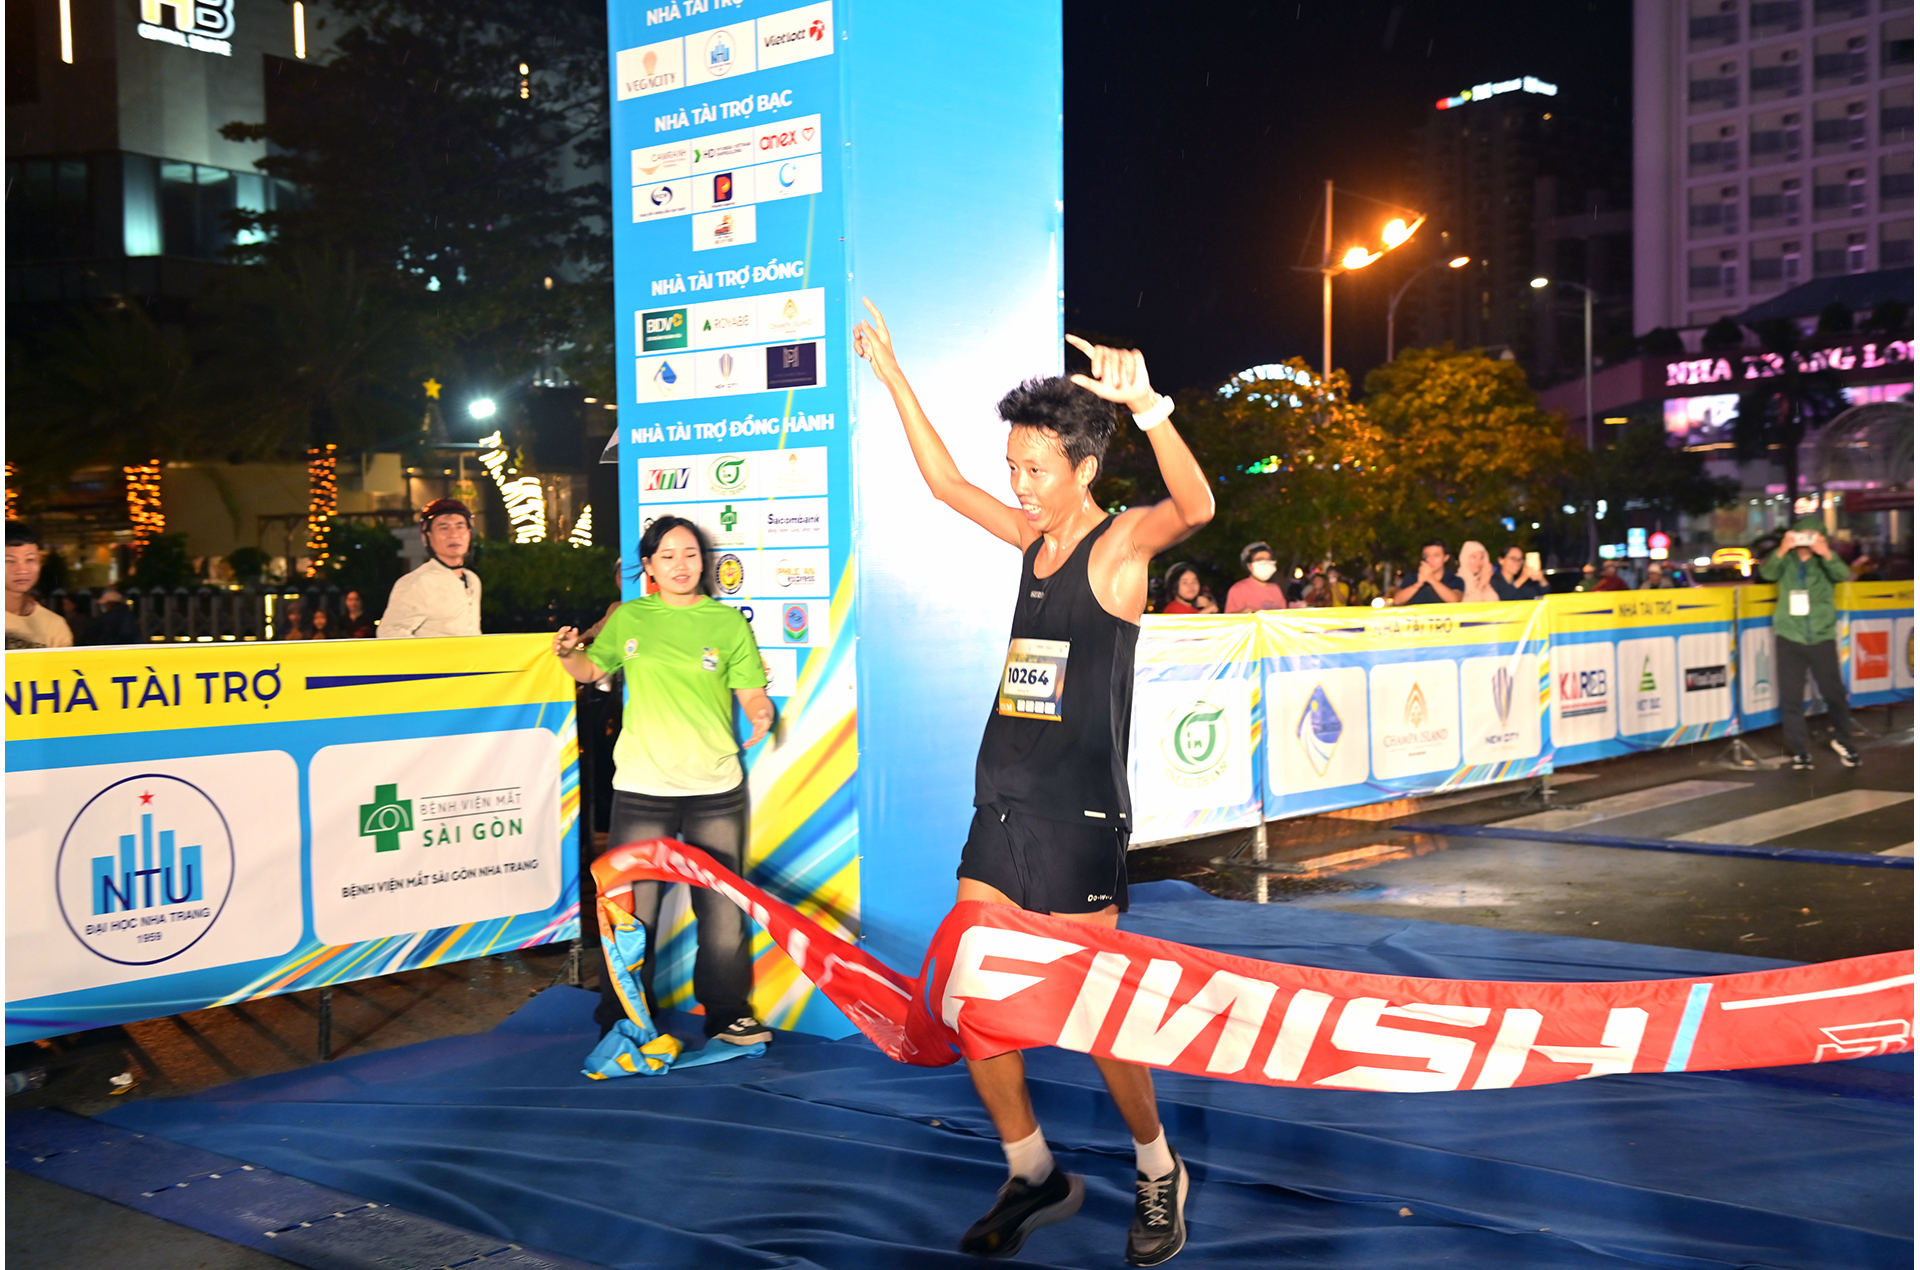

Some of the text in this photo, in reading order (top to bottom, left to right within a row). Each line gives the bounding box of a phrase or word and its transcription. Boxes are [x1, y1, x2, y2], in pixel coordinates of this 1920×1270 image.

[646, 0, 682, 26] NHÀ
[655, 89, 793, 133] NHÀ TÀI TRỢ BẠC
[759, 130, 798, 151] anex
[651, 258, 804, 297] NHÀ TÀI TRỢ ĐỒNG
[1666, 358, 1732, 386] NHA
[1862, 339, 1914, 368] LO
[631, 412, 835, 444] NHÀ TÀI TRỢ ĐỒNG HÀNH
[645, 468, 690, 491] KTV
[5, 662, 282, 716] NHÀ TÀI TRỢ
[1008, 667, 1049, 685] 10264
[419, 790, 522, 816] BỆNH VIỆN MẮT
[422, 815, 523, 848] SÀI GÒN
[102, 863, 193, 915] NTU
[341, 859, 539, 899] BỆNH VIỆN MẮT SÀI GÒN NHA TRANG
[85, 907, 211, 936] ĐẠI HỌC NHA TRANG
[136, 931, 163, 944] 1959
[942, 925, 1650, 1094] FINISH
